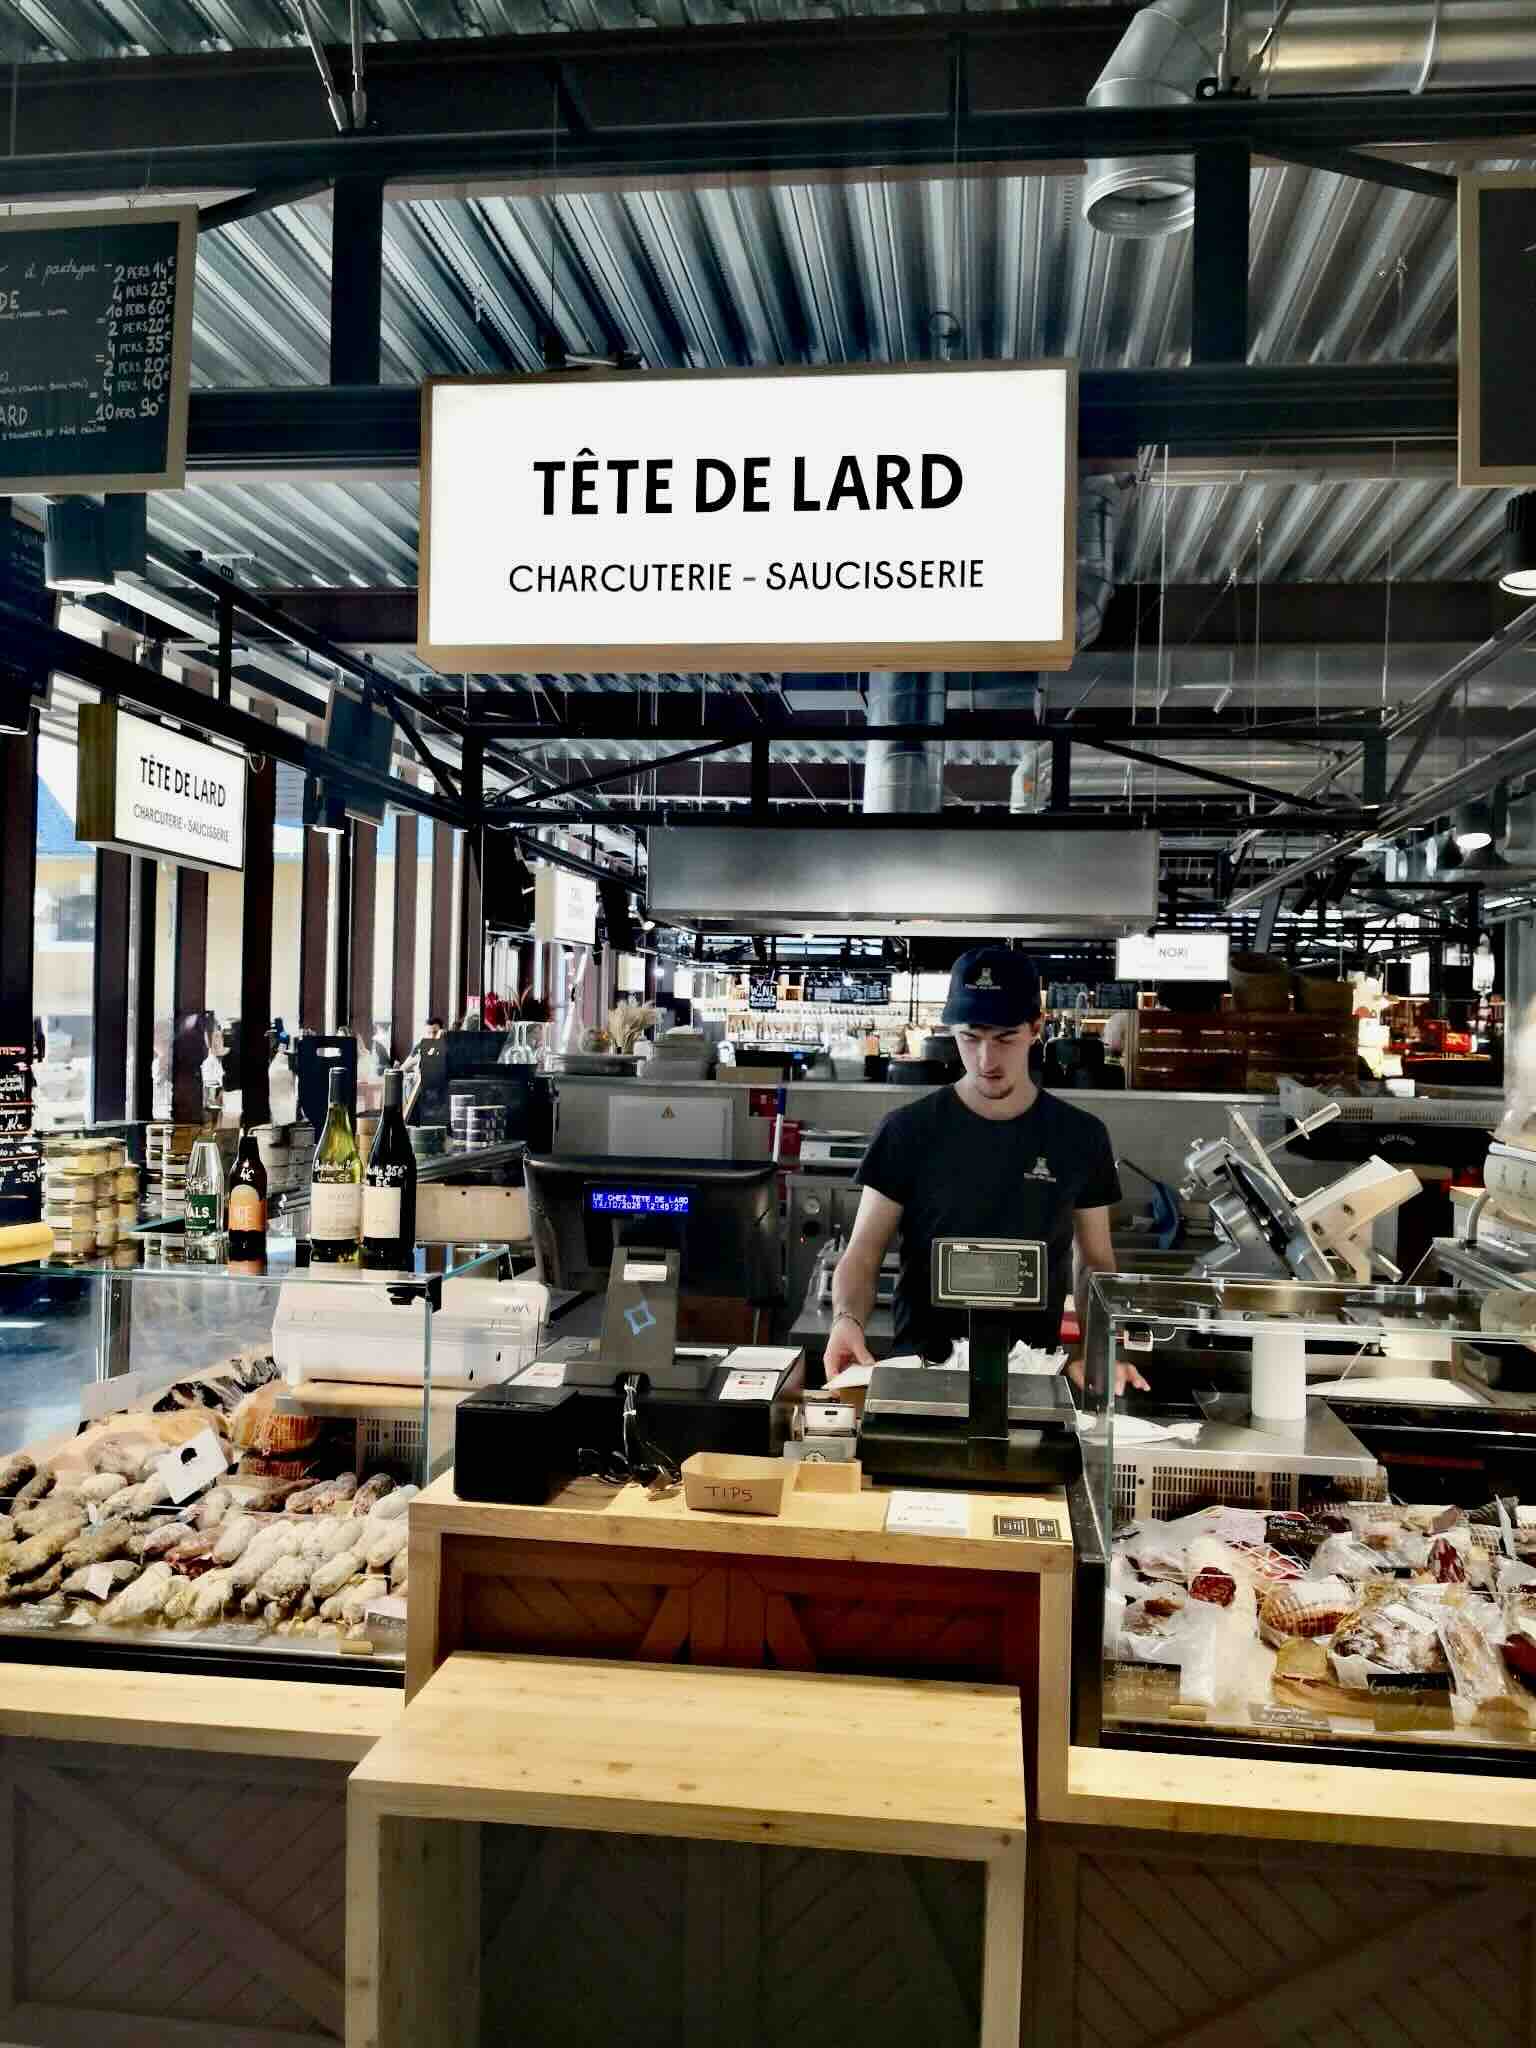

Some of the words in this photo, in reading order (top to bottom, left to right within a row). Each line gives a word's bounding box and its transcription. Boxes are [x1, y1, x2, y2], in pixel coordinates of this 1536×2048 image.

[534, 448, 673, 515] TÊTE
[695, 456, 770, 513] DE
[793, 453, 963, 511] LARD
[509, 563, 732, 593] CHARCUTERIE
[766, 559, 984, 591] SAUCISSERIE
[140, 754, 170, 791] TÊTE
[175, 768, 191, 797] DE
[194, 775, 226, 808] LARD
[134, 804, 182, 830] CHARCUTERIE
[704, 1486, 752, 1502] TIPS
